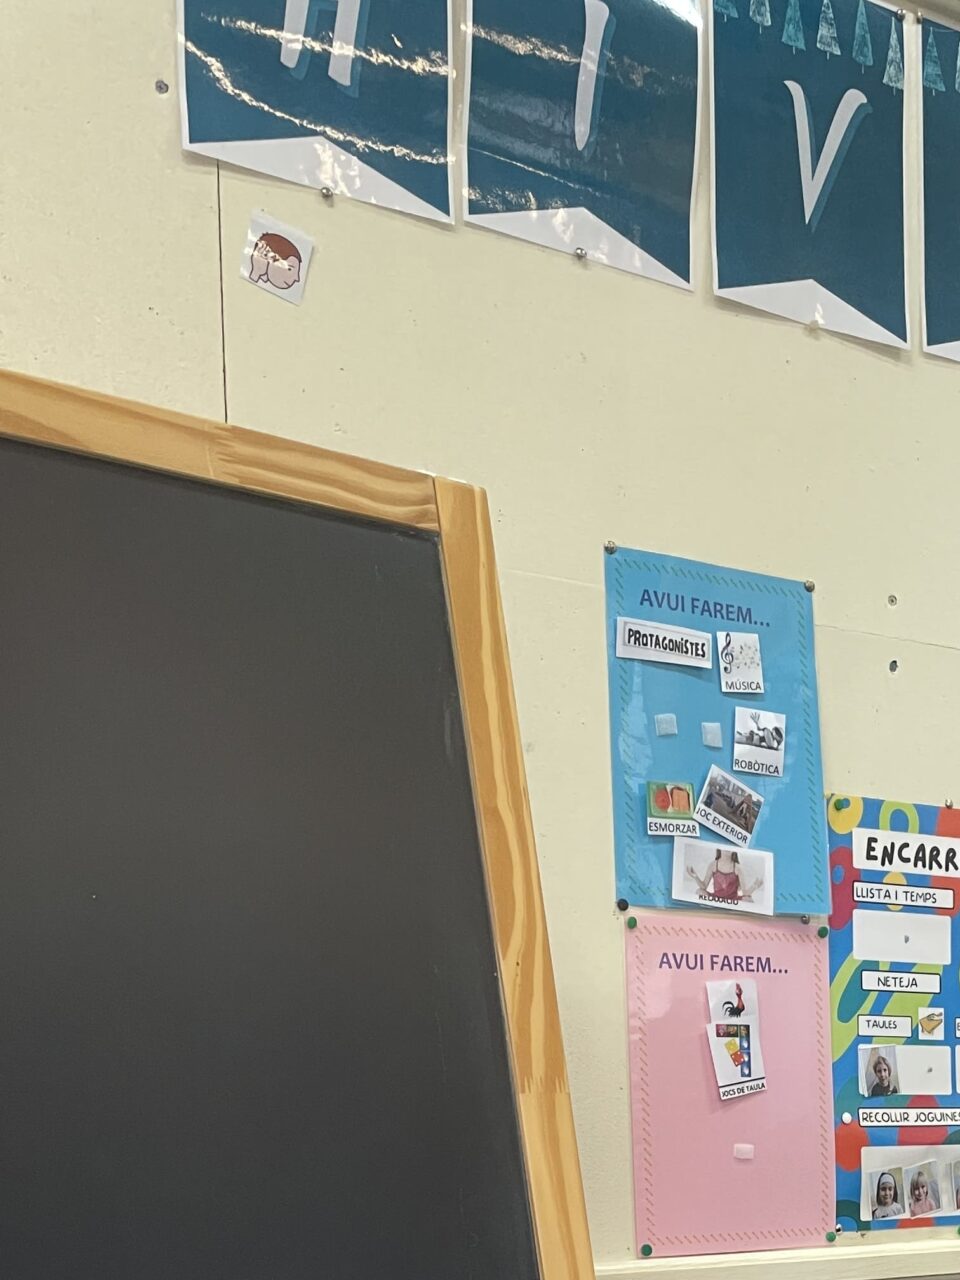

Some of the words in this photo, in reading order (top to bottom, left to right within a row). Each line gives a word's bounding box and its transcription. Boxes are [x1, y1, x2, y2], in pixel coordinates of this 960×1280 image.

[640, 588, 685, 613] AVUI
[691, 597, 771, 628] FAREM...
[725, 678, 762, 691] MÚSICA
[734, 759, 780, 775] ROBÒTICA
[648, 821, 698, 834] ESMORZAR
[712, 814, 749, 844] EXTERIOR
[855, 887, 891, 900] LLISTA
[902, 890, 937, 904] TEMPS
[658, 952, 704, 970] AVUI
[710, 954, 788, 974] FAREM...
[877, 976, 918, 988] NETEJA
[865, 1019, 898, 1030] TAULES
[737, 1086, 746, 1094] DE
[861, 1111, 910, 1123] RECOLLIR
